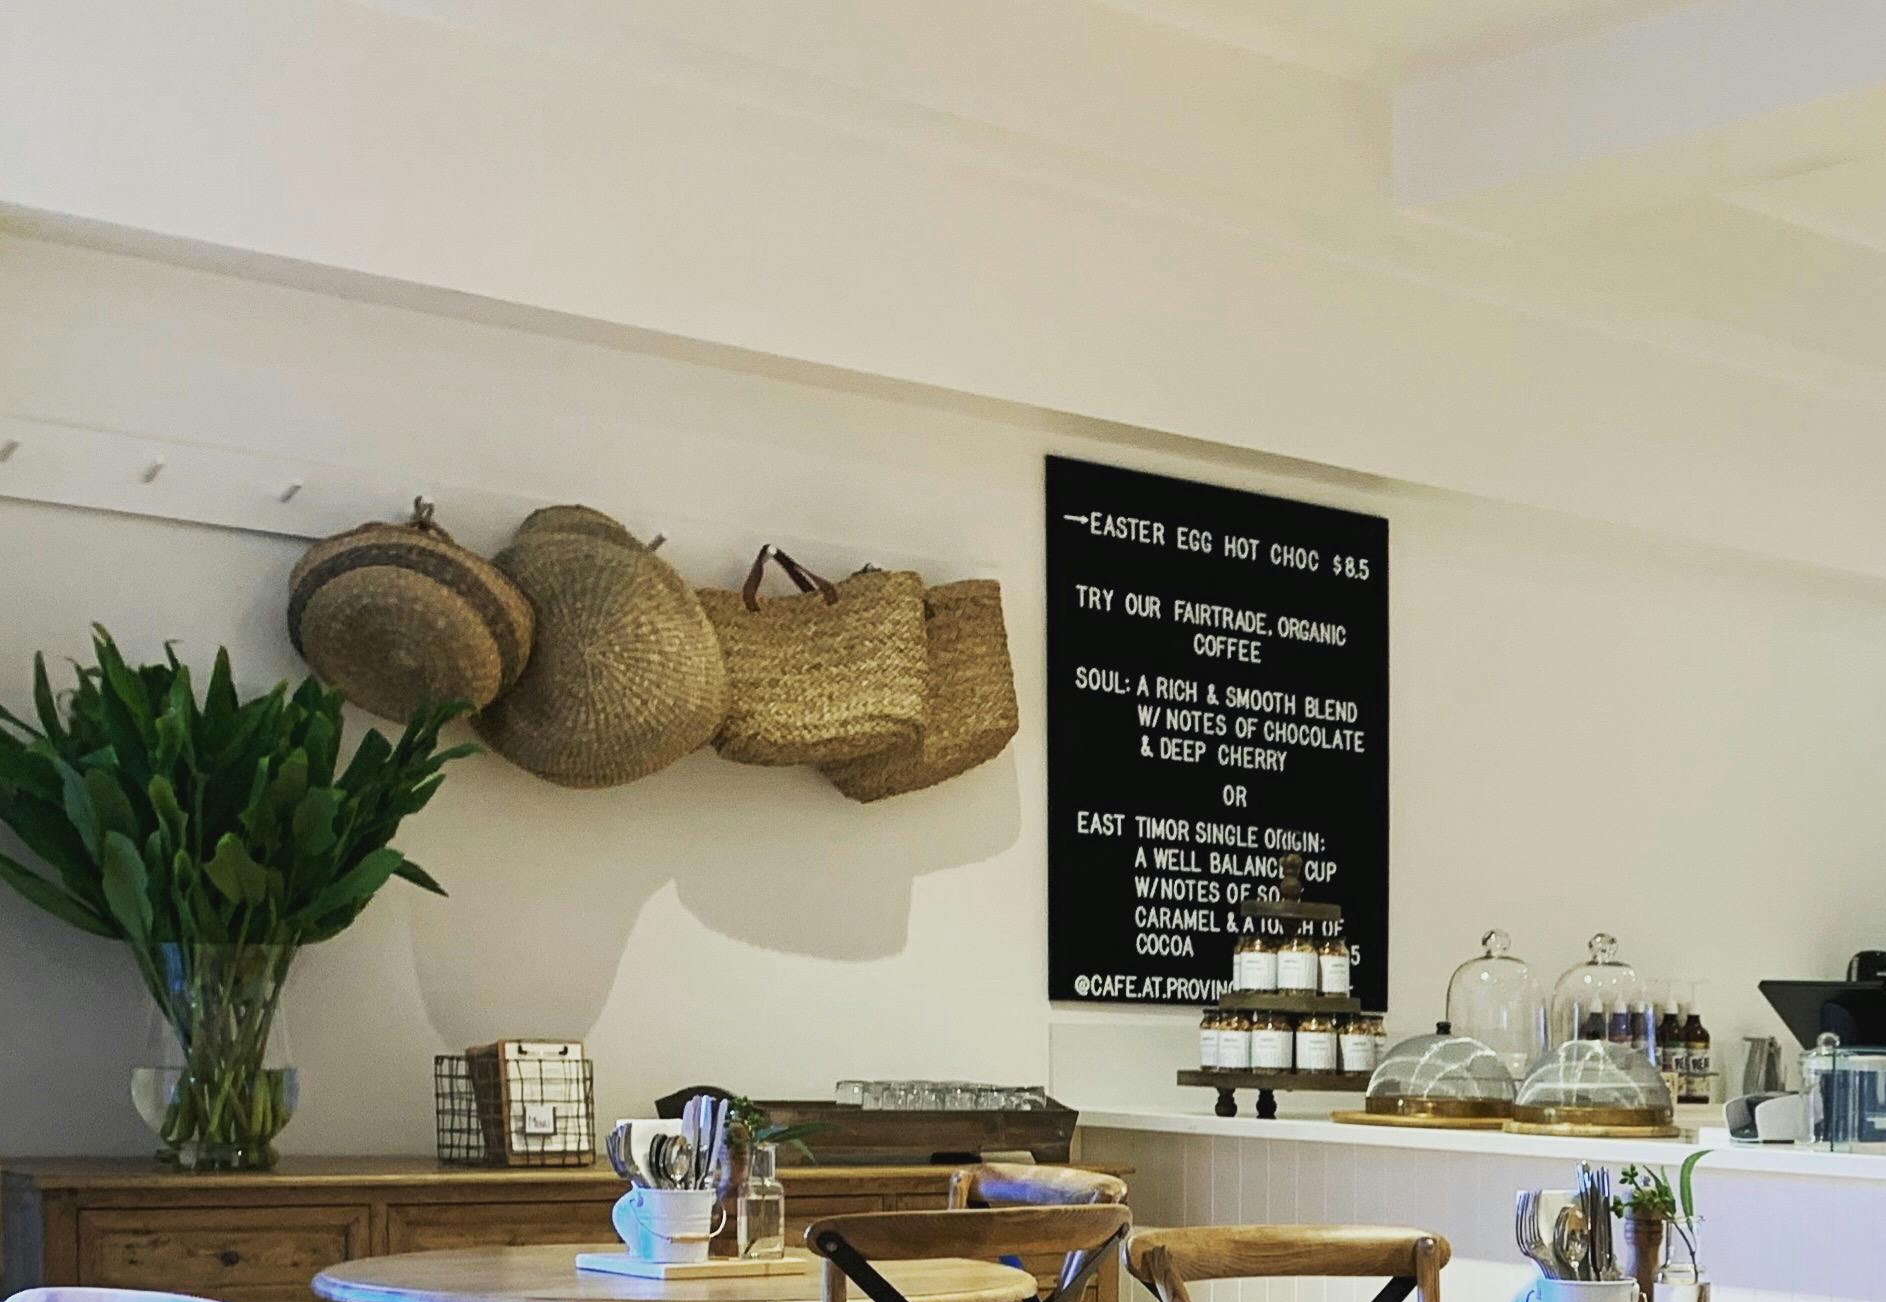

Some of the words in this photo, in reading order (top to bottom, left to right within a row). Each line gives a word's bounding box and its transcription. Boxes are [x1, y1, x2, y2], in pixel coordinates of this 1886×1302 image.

[1090, 511, 1166, 546] EASTER
[1176, 526, 1213, 554] EGG
[1224, 535, 1260, 561] HOT
[1270, 543, 1319, 572] CHOC
[1333, 554, 1370, 581] $8.5
[1075, 584, 1114, 612] TRY
[1125, 592, 1162, 619] OUR
[1174, 599, 1273, 637] FAIRTRADE,
[1277, 615, 1347, 647] ORGANIC
[1193, 632, 1262, 664] COFFEE
[1075, 666, 1131, 695] SOUL:
[1136, 674, 1150, 697] A
[1156, 676, 1198, 703] RICH
[1206, 683, 1220, 706] &
[1225, 685, 1296, 716] SMOOTH
[1304, 696, 1358, 725] BLEND
[1137, 703, 1161, 728] W/
[1166, 708, 1227, 736] NOTES
[1234, 716, 1259, 739] OF
[1263, 719, 1365, 753] CHOCOLATE
[1140, 734, 1154, 758] &
[1160, 736, 1207, 763] DEEP
[1217, 743, 1288, 772] CHERRY
[1222, 784, 1248, 808] OR
[1077, 810, 1126, 837] EAST
[1134, 815, 1190, 843] TIMOR
[1195, 821, 1259, 848] SINGLE
[1134, 846, 1148, 869] A
[1153, 847, 1202, 873] WELL
[1209, 851, 1287, 880] BALANC
[1304, 860, 1337, 883] CUP
[1226, 882, 1252, 905] OF
[1134, 905, 1221, 933] CARAMEL
[1226, 911, 1240, 934] &
[1242, 915, 1255, 934] A
[1320, 918, 1345, 937] OF
[1135, 932, 1195, 958] COCOA
